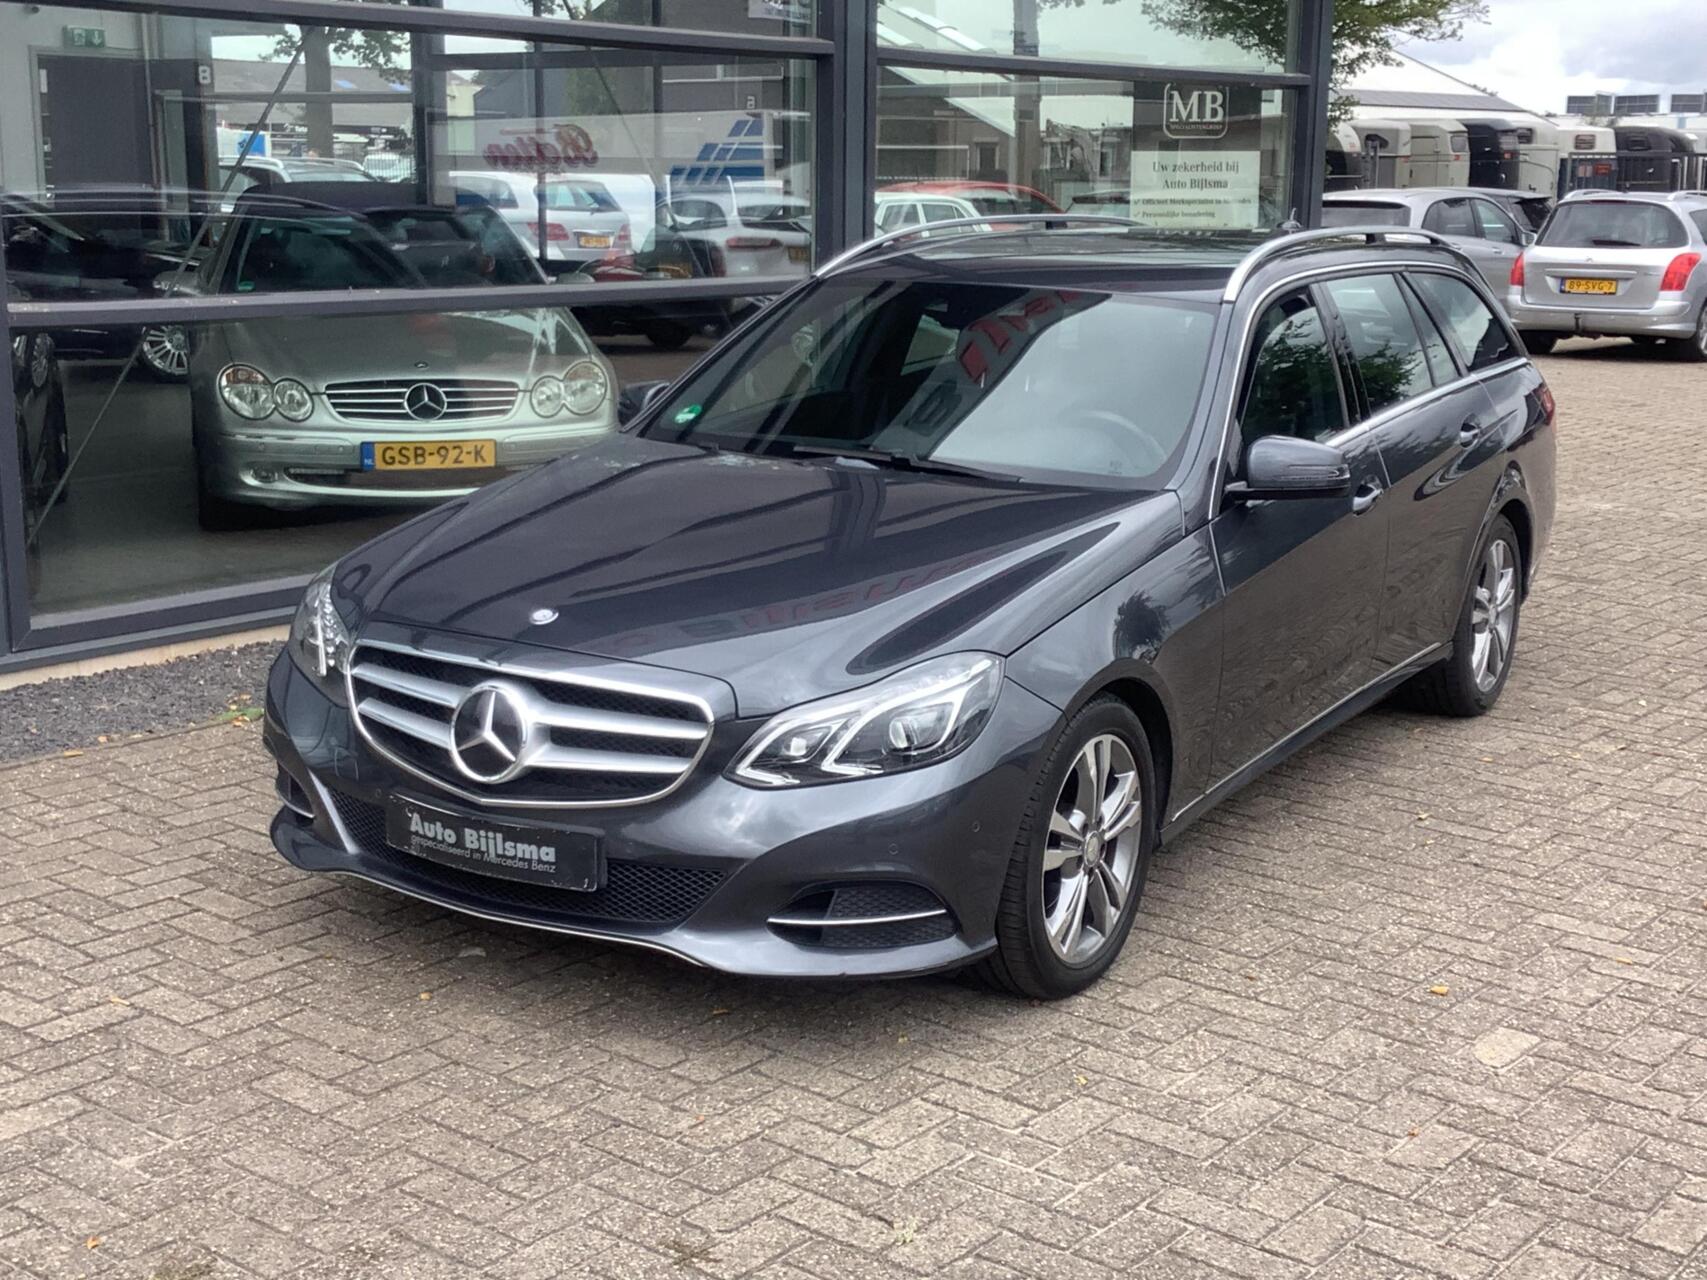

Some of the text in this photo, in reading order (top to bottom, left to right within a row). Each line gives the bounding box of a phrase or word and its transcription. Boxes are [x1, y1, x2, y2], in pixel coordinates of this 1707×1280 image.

[1169, 90, 1224, 122] MB
[1171, 161, 1223, 173] zekerheid
[1225, 161, 1239, 175] bij
[1162, 178, 1229, 192] Auto Bijlsma
[381, 444, 487, 466] GSB-92-K
[410, 812, 556, 862] Auto Bijlsma
[531, 860, 556, 874] Benz
